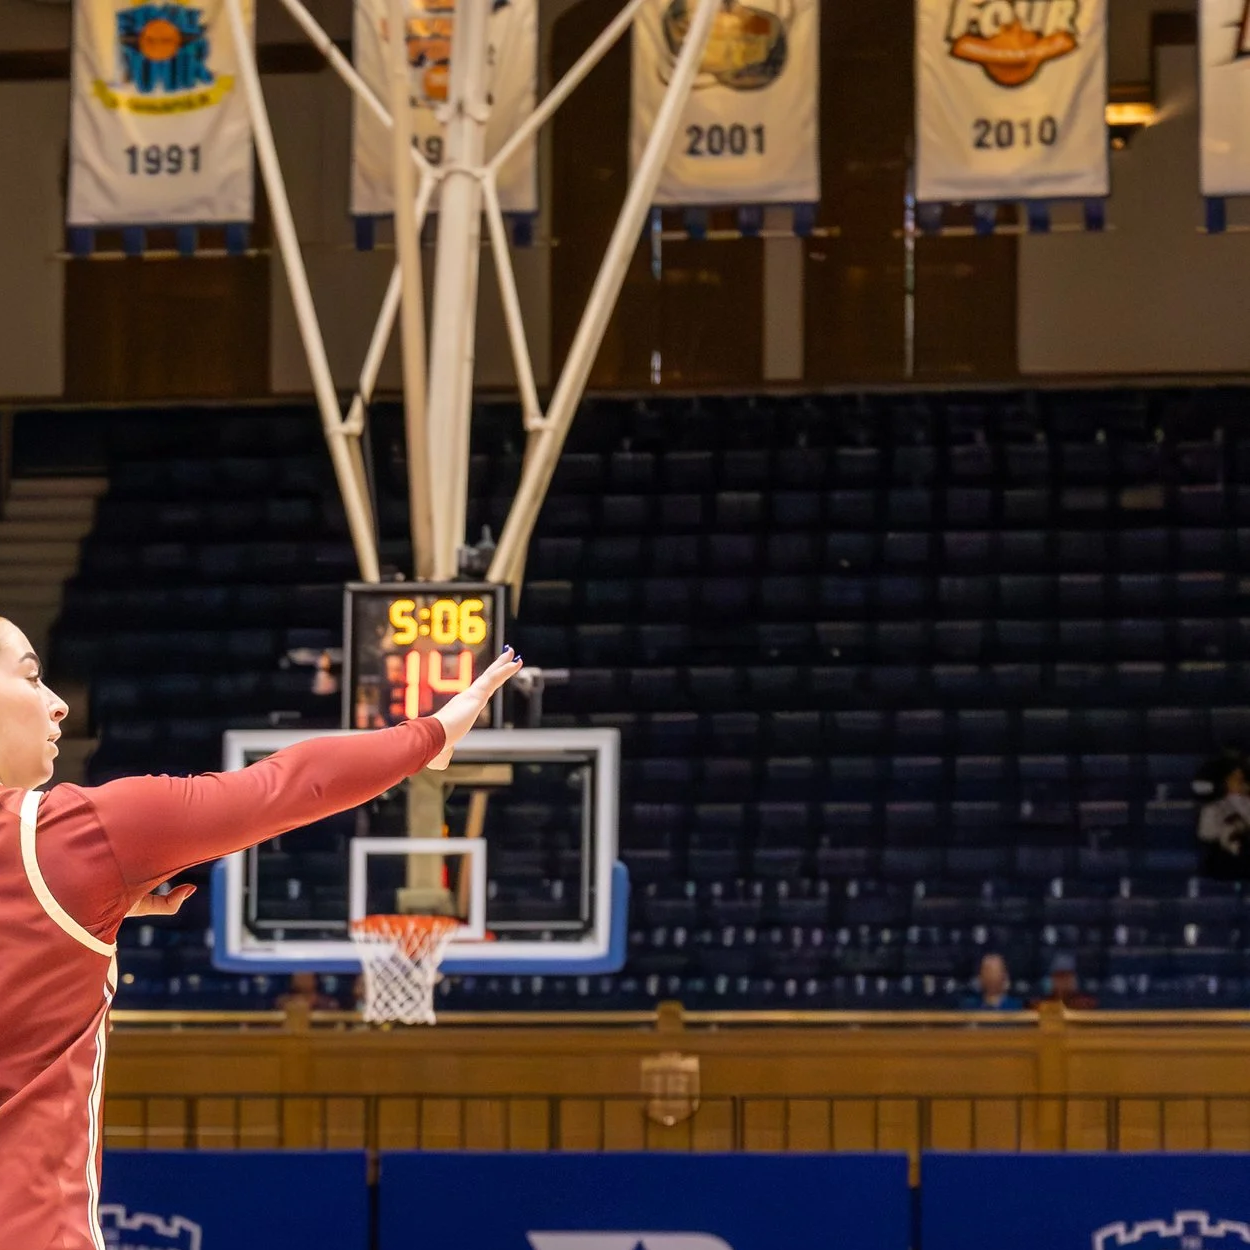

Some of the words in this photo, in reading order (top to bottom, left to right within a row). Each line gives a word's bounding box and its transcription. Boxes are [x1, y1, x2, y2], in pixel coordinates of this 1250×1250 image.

[684, 122, 768, 157] 2001
[972, 115, 1058, 151] 2010
[124, 143, 203, 176] 1991
[388, 598, 488, 645] 5:06
